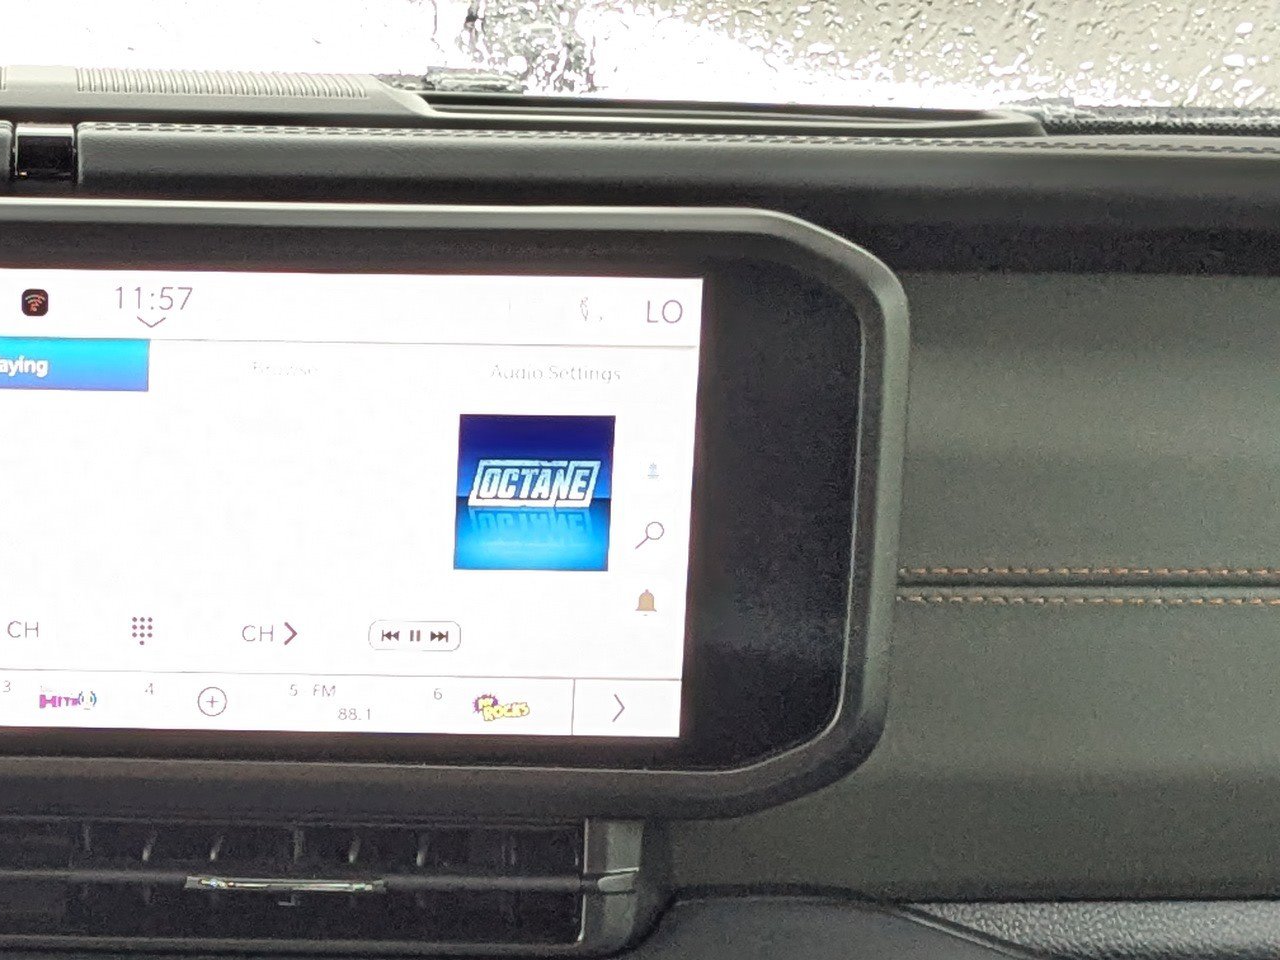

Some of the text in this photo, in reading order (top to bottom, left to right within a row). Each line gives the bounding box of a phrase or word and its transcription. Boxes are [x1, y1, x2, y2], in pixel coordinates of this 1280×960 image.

[116, 286, 194, 312] 11:57
[646, 299, 683, 324] LO
[480, 467, 592, 500] OCTANE
[7, 621, 40, 639] CH
[241, 624, 274, 642] CH
[338, 707, 372, 721] 88.1
